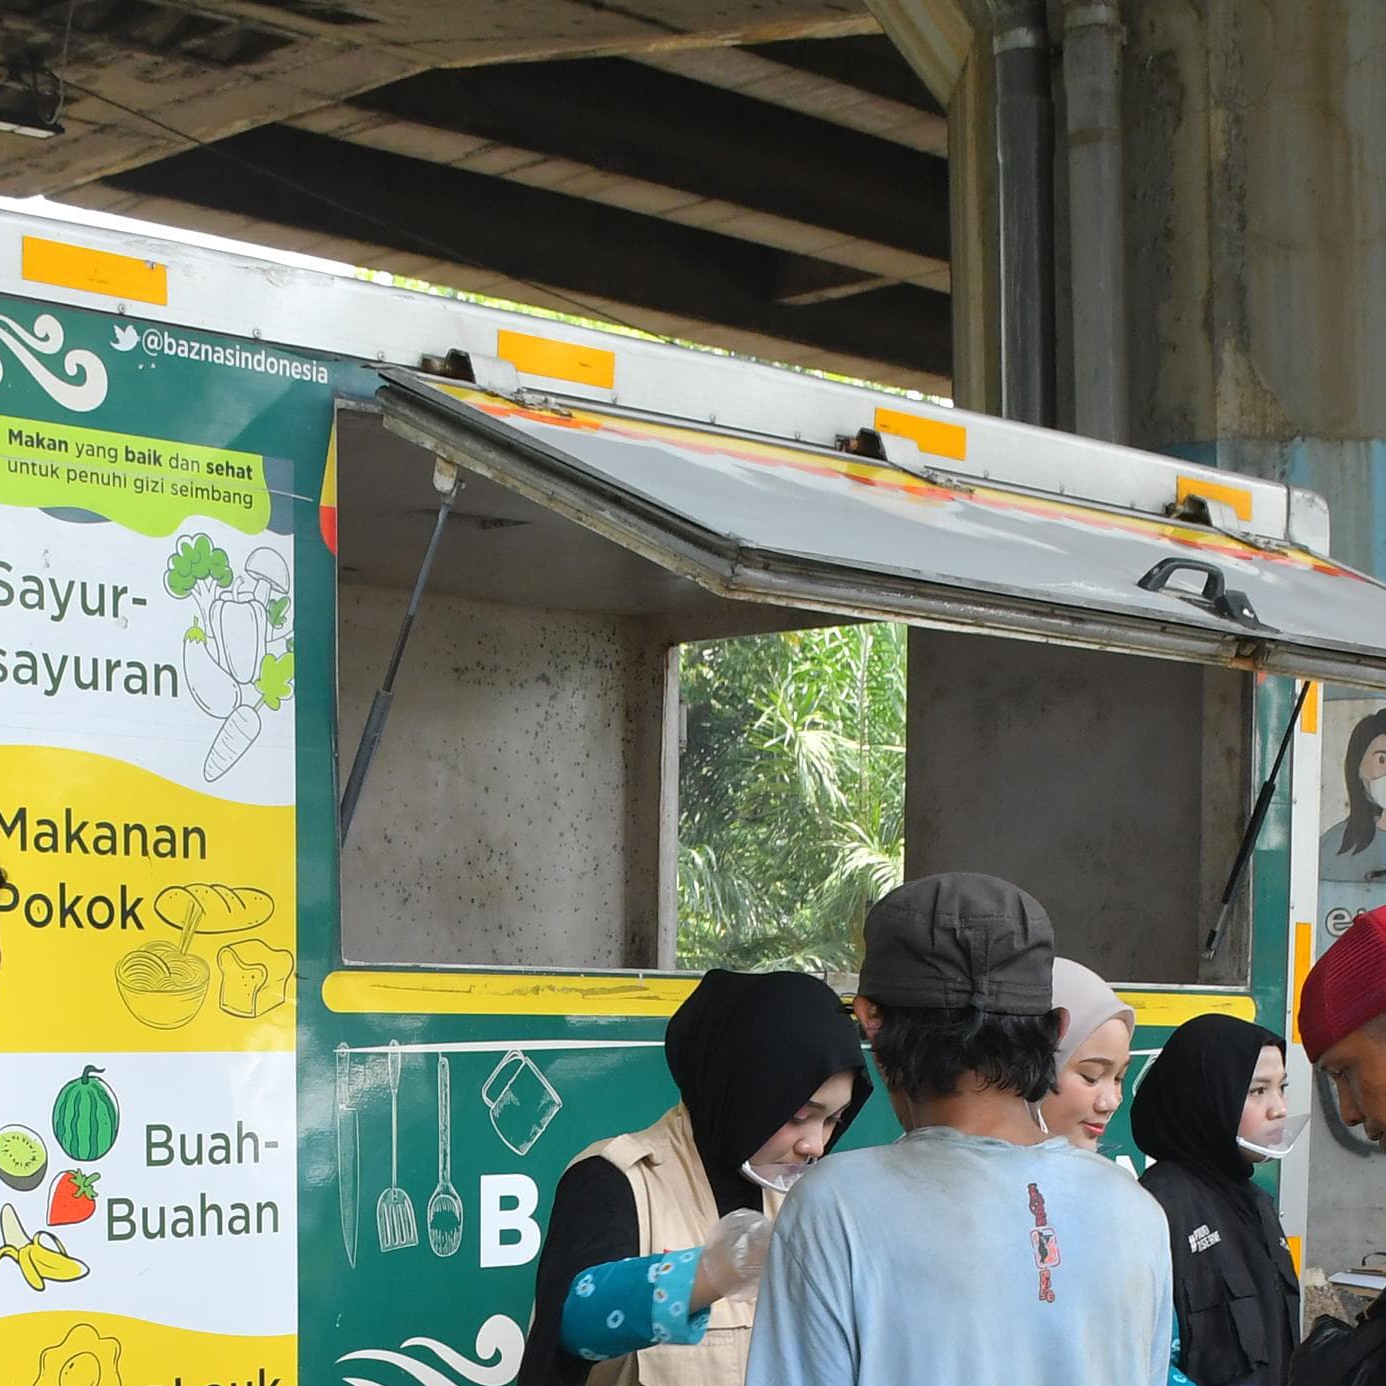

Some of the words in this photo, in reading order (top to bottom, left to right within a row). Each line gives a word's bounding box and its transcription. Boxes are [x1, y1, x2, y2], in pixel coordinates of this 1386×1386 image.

[141, 327, 329, 386] @baznasindonesia
[7, 428, 69, 453] Makan
[74, 441, 119, 464] yang
[124, 445, 163, 468] baik
[168, 452, 201, 474] dan
[205, 459, 254, 481] sehat
[7, 458, 60, 480] untuk
[66, 466, 128, 490] penuhi
[133, 475, 165, 495] gizi
[170, 480, 254, 510] seimbang
[144, 1120, 280, 1168] Buah-
[105, 1192, 280, 1243] Buahan
